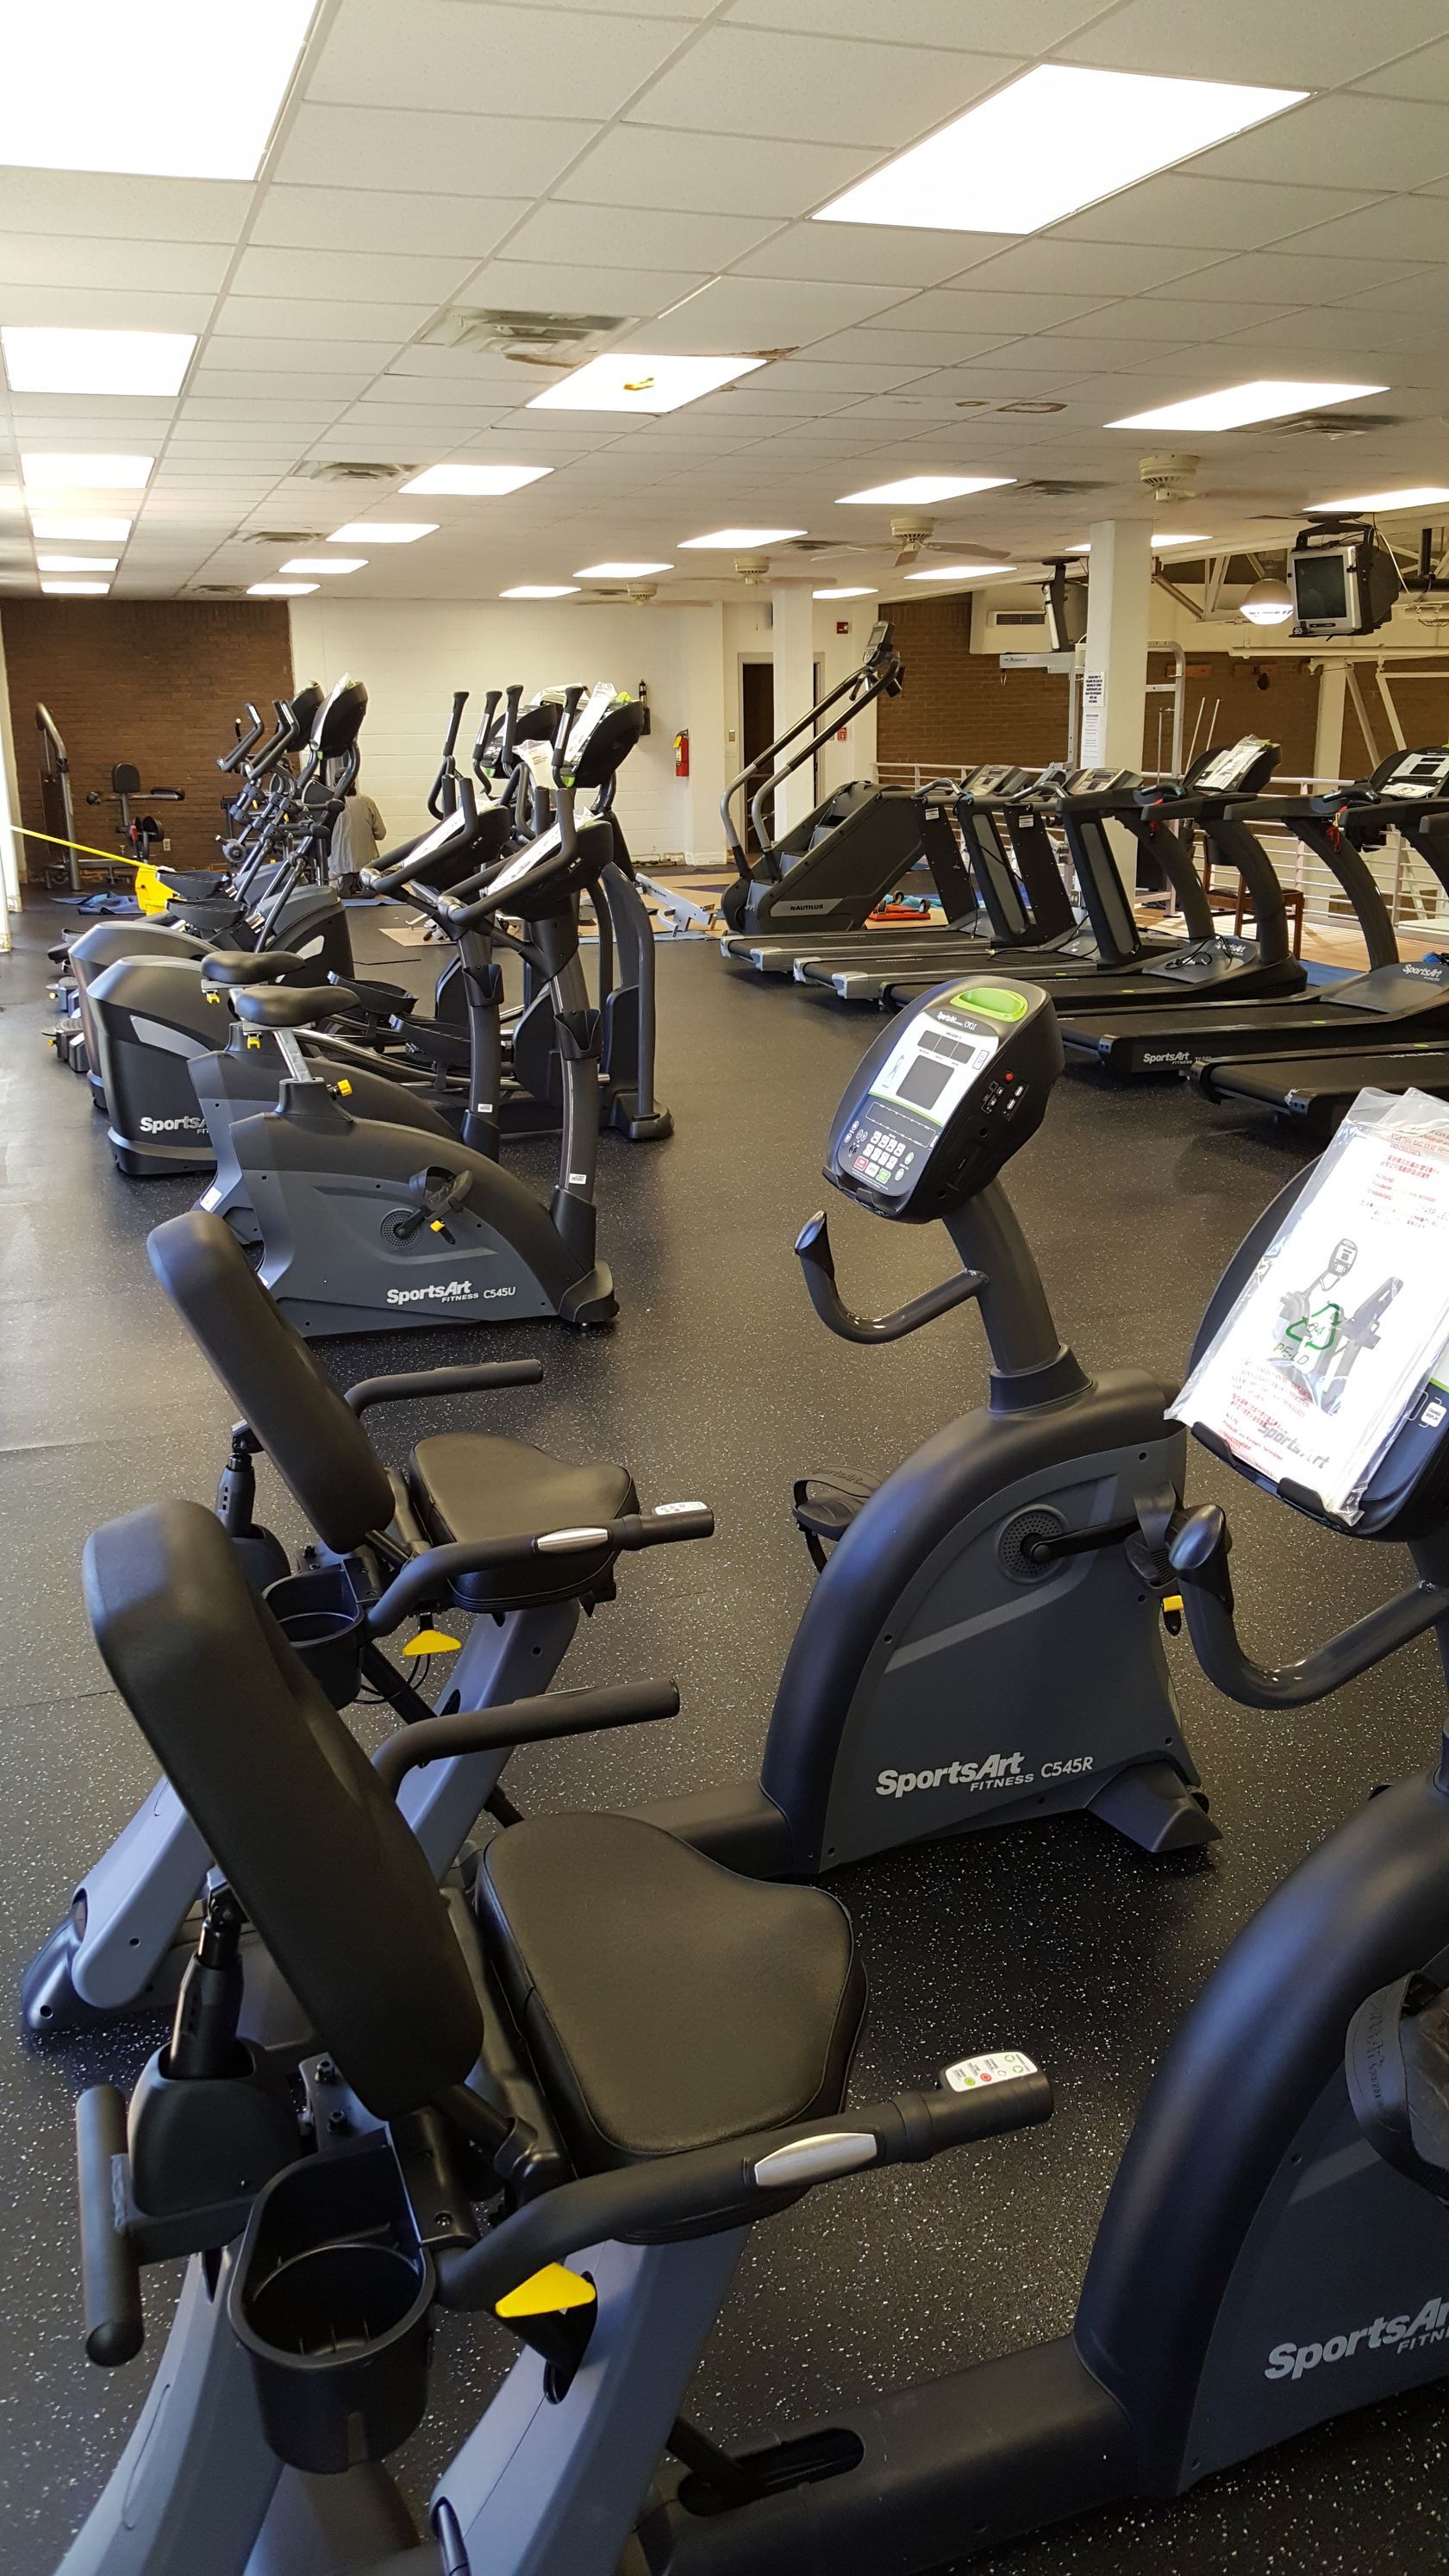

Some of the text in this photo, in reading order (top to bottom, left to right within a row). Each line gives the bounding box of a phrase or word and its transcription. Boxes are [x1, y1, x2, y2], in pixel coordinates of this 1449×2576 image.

[1402, 964, 1443, 978] SportsArt
[1143, 1051, 1190, 1064] SportsArt
[386, 1280, 472, 1305] SportsArt
[441, 1286, 516, 1303] FITNESS C545U
[1306, 1322, 1326, 1336] 04
[1272, 1342, 1310, 1366] PE-LD
[875, 1751, 1025, 1798] SportsArt
[970, 1756, 1095, 1792] FITNESS C545R
